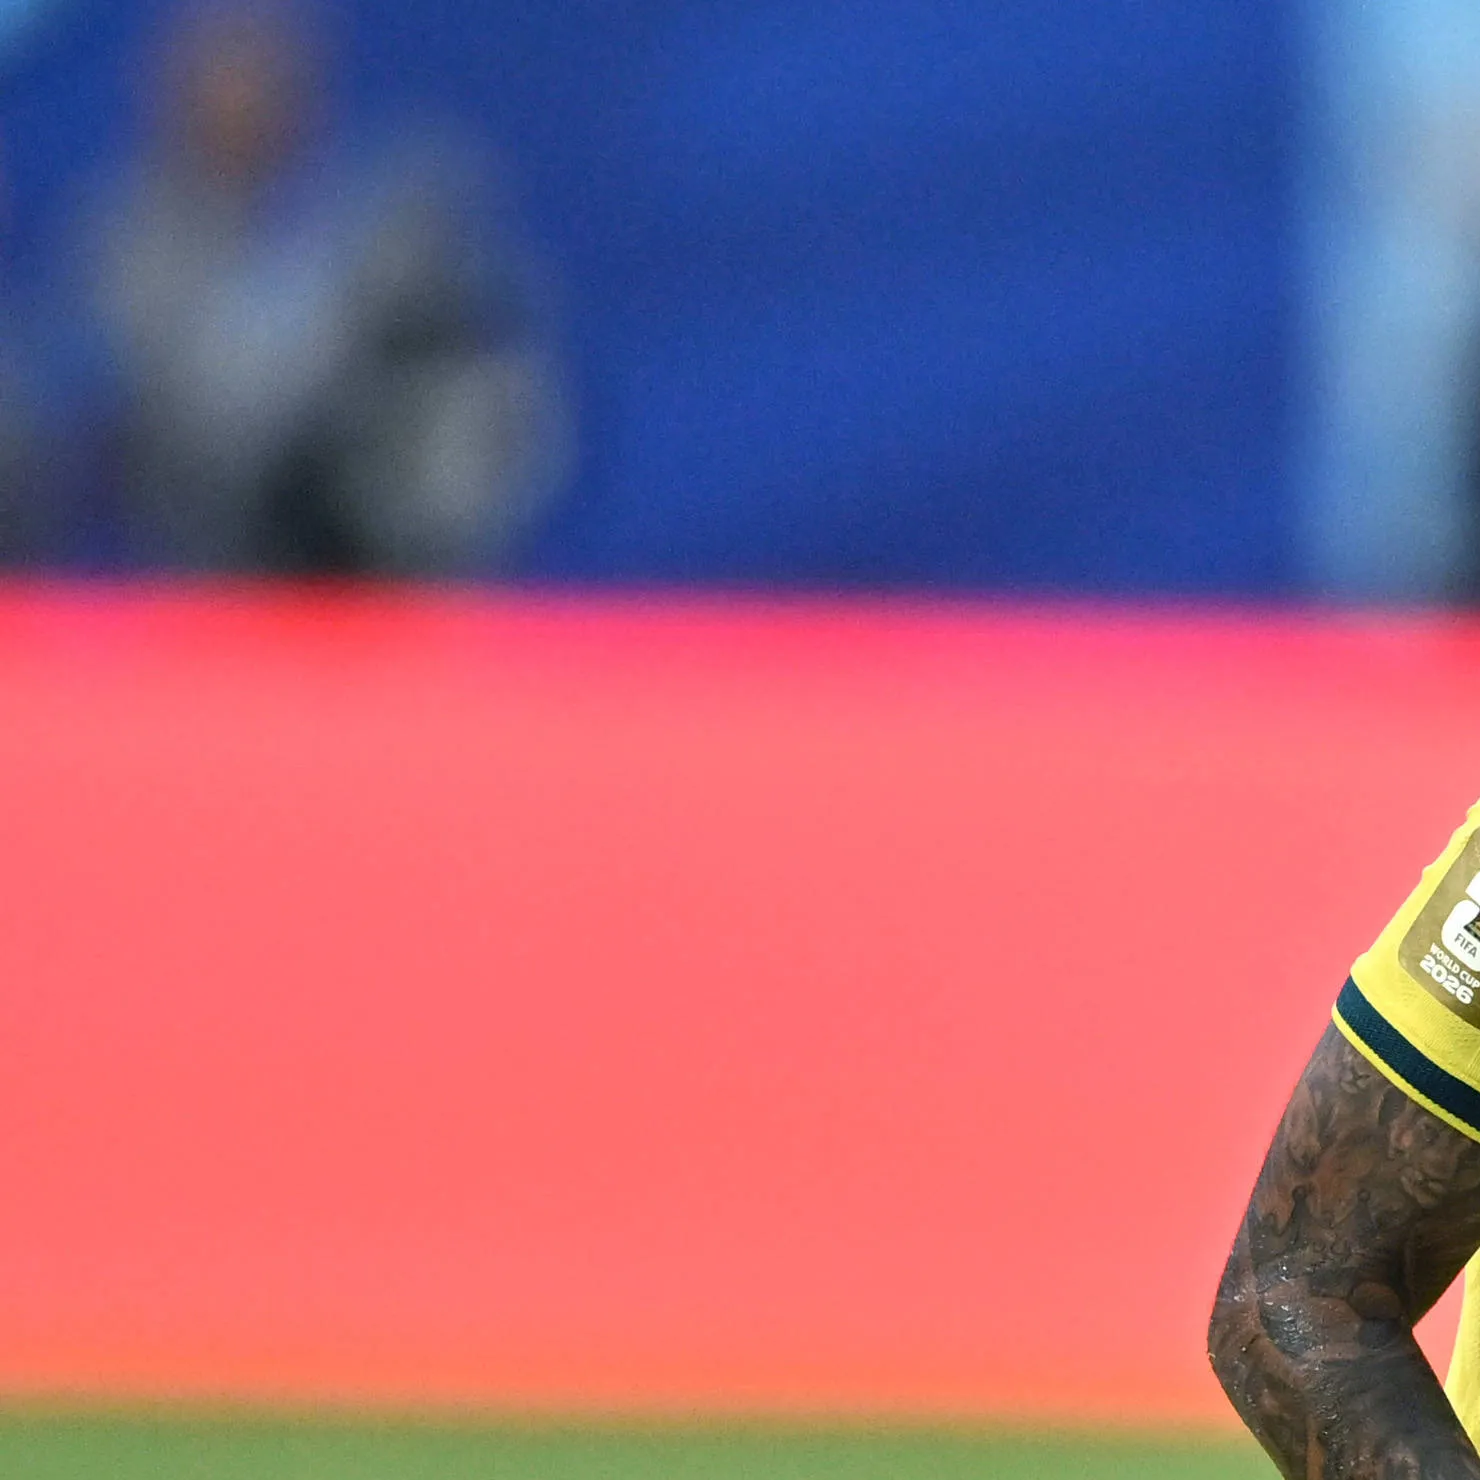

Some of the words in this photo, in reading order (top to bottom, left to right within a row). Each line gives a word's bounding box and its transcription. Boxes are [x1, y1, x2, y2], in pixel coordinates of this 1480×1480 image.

[1429, 942, 1461, 975] WORLD
[1459, 969, 1480, 989] CUP
[1454, 933, 1478, 958] FIFA
[1419, 954, 1475, 1005] 2026
